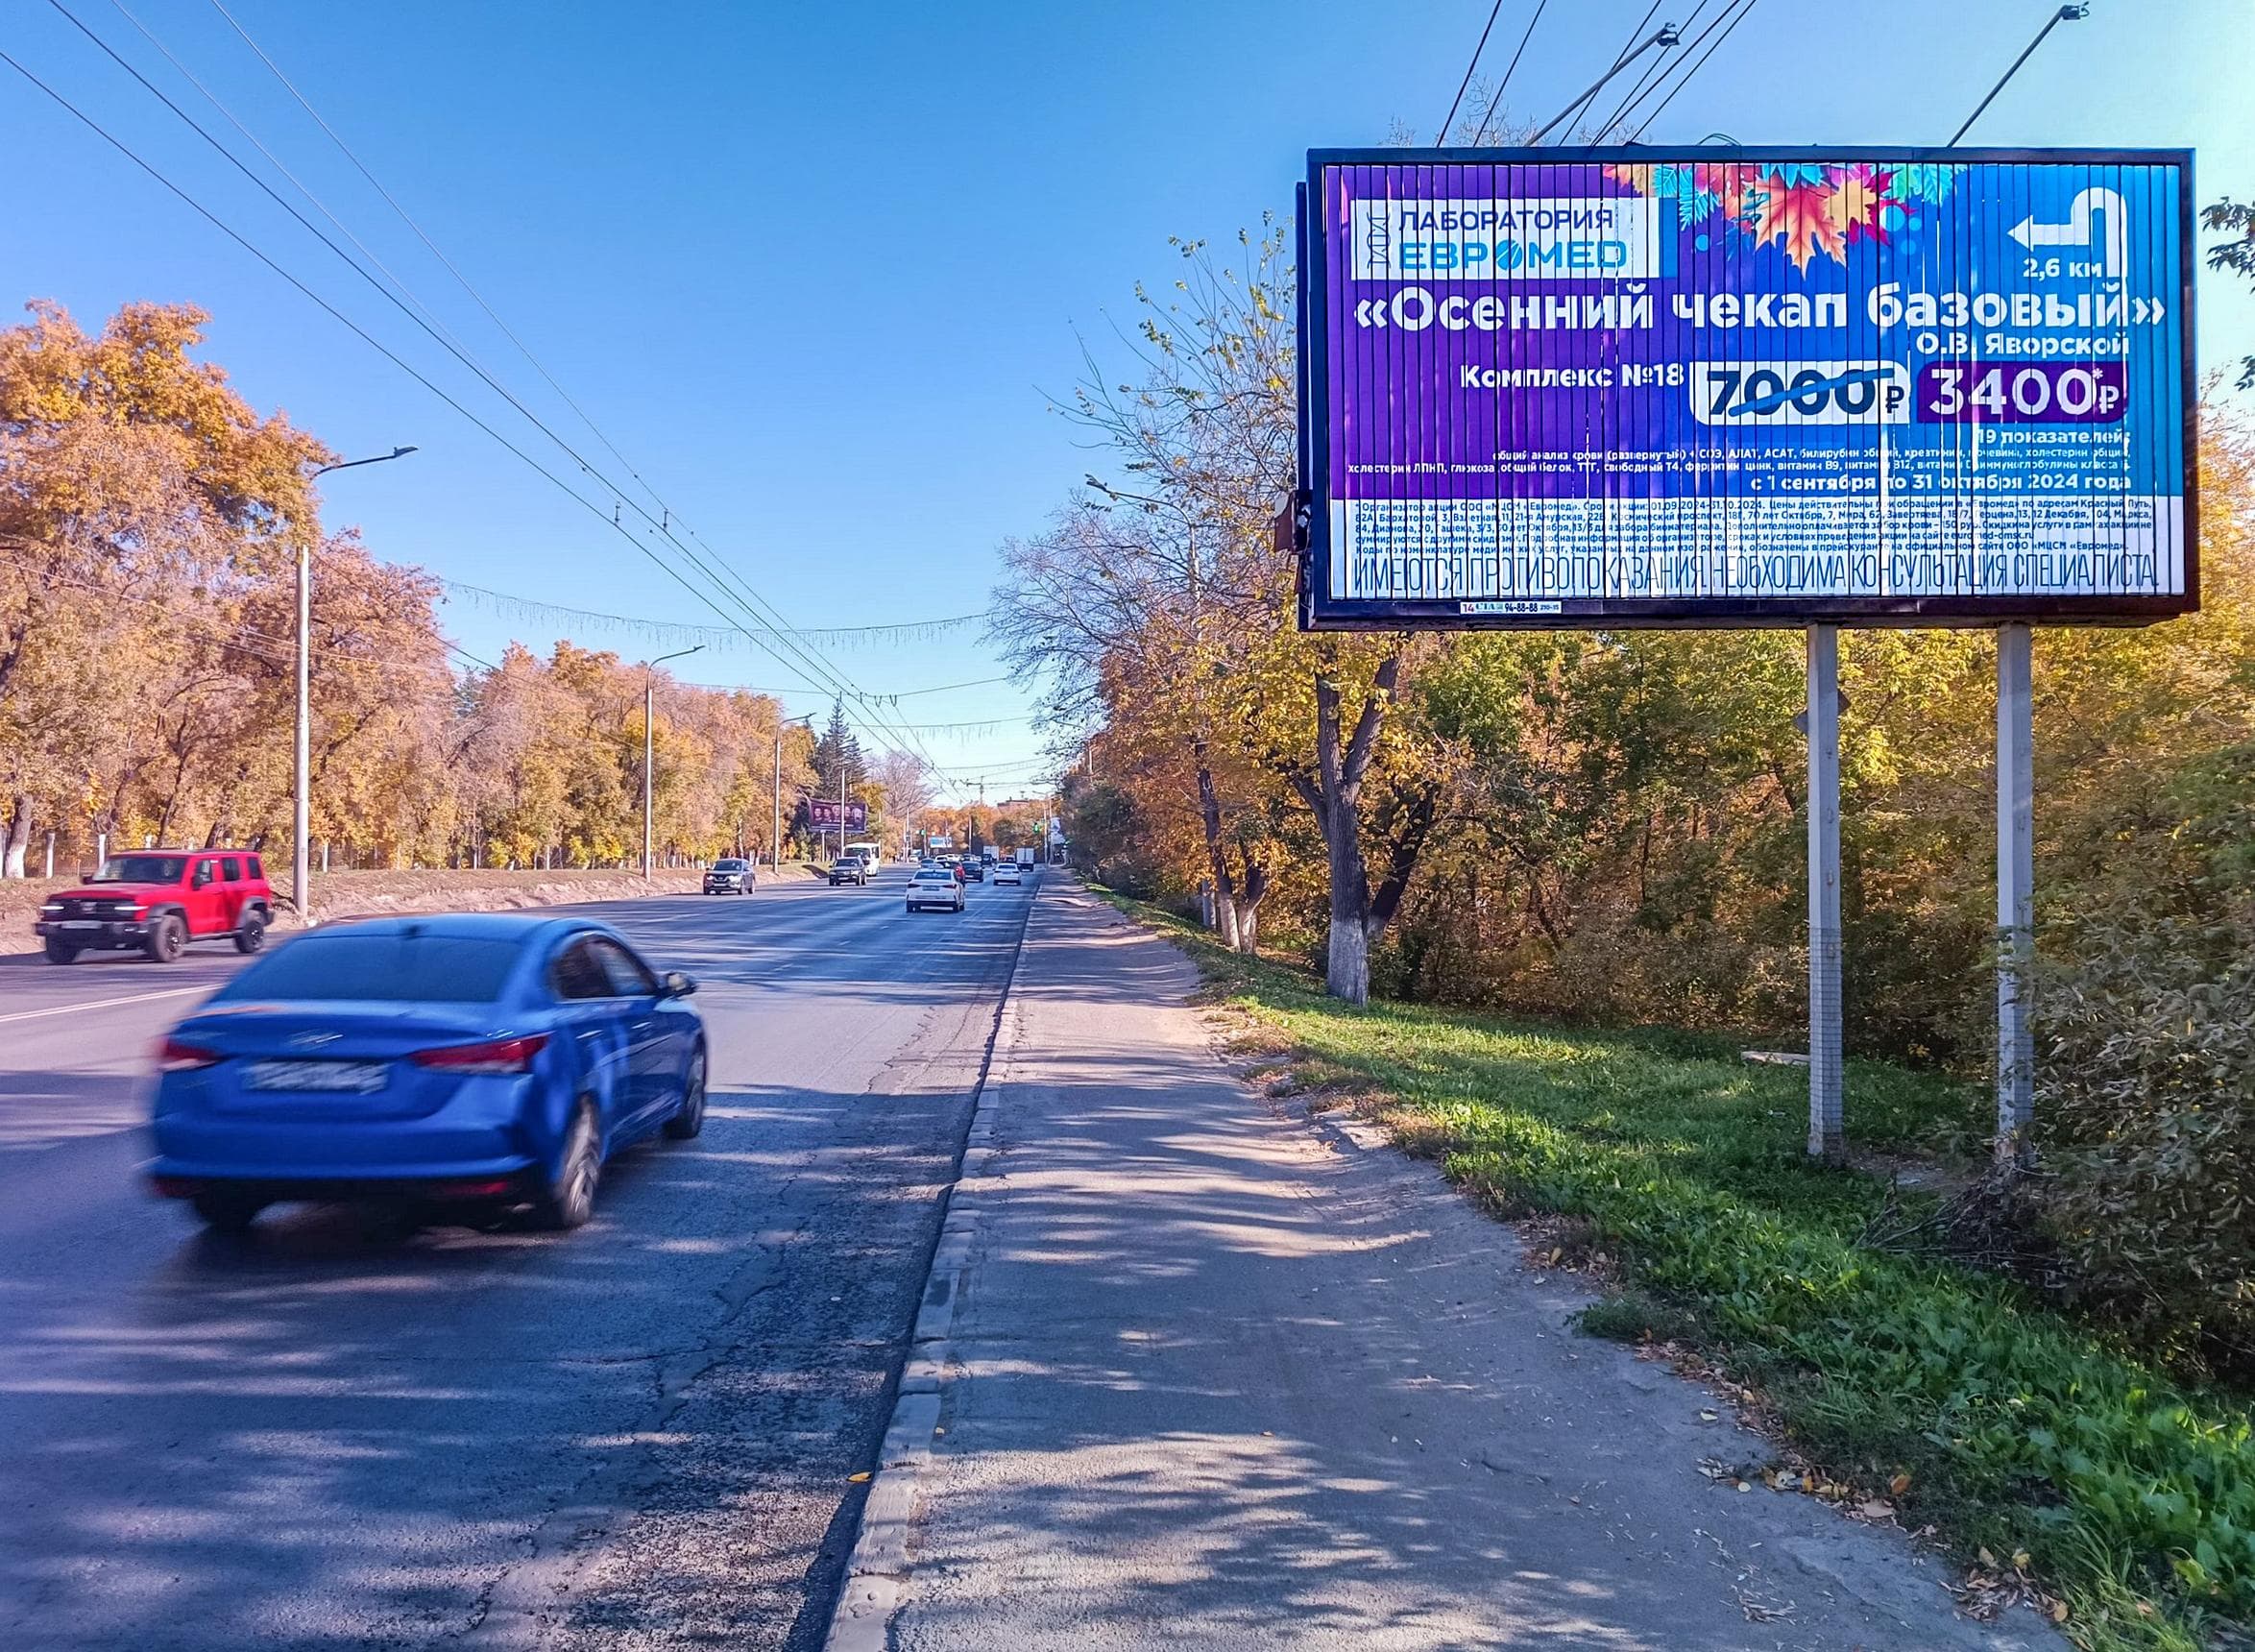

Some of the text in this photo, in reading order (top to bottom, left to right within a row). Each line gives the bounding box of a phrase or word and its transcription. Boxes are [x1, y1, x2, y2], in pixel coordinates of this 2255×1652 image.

[1398, 209, 1613, 231] ЛАБОРАТОРИЯ
[2023, 257, 2102, 279] 2,6 км
[1354, 280, 2167, 331] «Осенний чекап базовый»
[1916, 331, 2129, 359] О.В. Яворской
[1460, 363, 1685, 388] Комплекс №18
[1978, 429, 1997, 444] 19
[1764, 448, 1797, 459] АСАТ,
[1801, 449, 1859, 459] билирубин
[1863, 448, 1902, 459] обий,
[2025, 449, 2088, 458] холестерин
[1604, 461, 1663, 474] свободный
[1666, 461, 1683, 473] Т4,
[1845, 460, 1890, 470] витамн
[1750, 474, 2132, 493] с 1 сентября по 31 октября 2024 года
[1362, 502, 1425, 512] Организтор
[1428, 503, 1458, 512] ации
[1769, 500, 1796, 510] Цены
[1896, 498, 1953, 509] обращении
[2037, 499, 2079, 509] адресам
[2080, 498, 2125, 509] Красный
[2127, 498, 2152, 509] Путь,
[1612, 511, 1675, 522] Ксмический
[1781, 511, 1826, 522] Октбря,
[2094, 509, 2112, 520] 04,
[2115, 509, 2152, 520] Мркса,
[1371, 523, 1418, 535] Дианоа,
[2073, 522, 2108, 530] рамах
[1577, 533, 1640, 545] информция
[1922, 531, 1950, 540] сайе
[1353, 557, 1463, 591] ИМЕЮТСЯ
[1713, 554, 1846, 592] НЕОБХОДИМА
[1852, 553, 2008, 590] КОНСУЛЬТАЦИЯ
[1463, 603, 1475, 613] 14
[1504, 602, 1539, 613] 94-88-88
